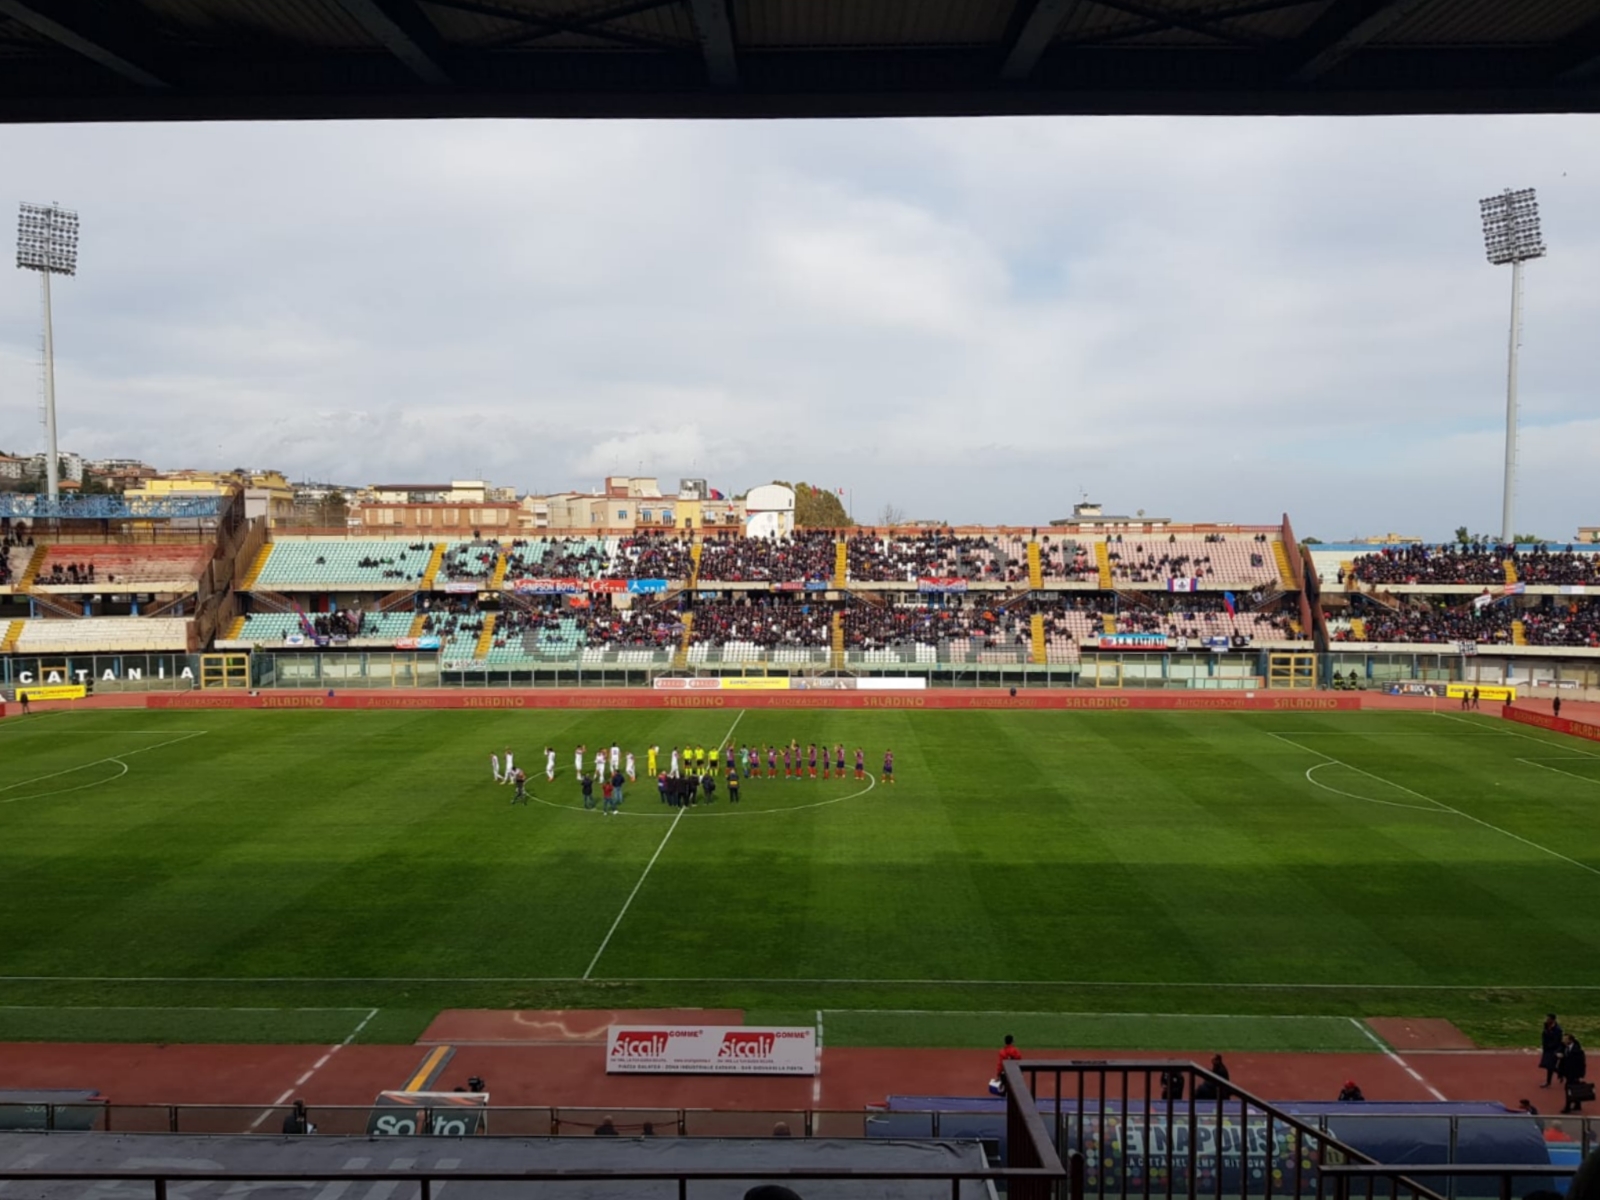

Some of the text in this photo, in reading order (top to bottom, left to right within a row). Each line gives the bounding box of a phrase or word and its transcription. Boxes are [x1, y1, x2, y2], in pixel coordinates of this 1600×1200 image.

[19, 667, 194, 684] CATANIA
[262, 697, 324, 707] SALADINO
[463, 697, 525, 707] SALADINO
[663, 697, 725, 706] SALADINO
[863, 697, 925, 706] SALADINO
[1066, 697, 1129, 707] SALADINO
[1274, 698, 1338, 708] SALADINO
[613, 1035, 664, 1056] sicali
[719, 1036, 771, 1056] sicali
